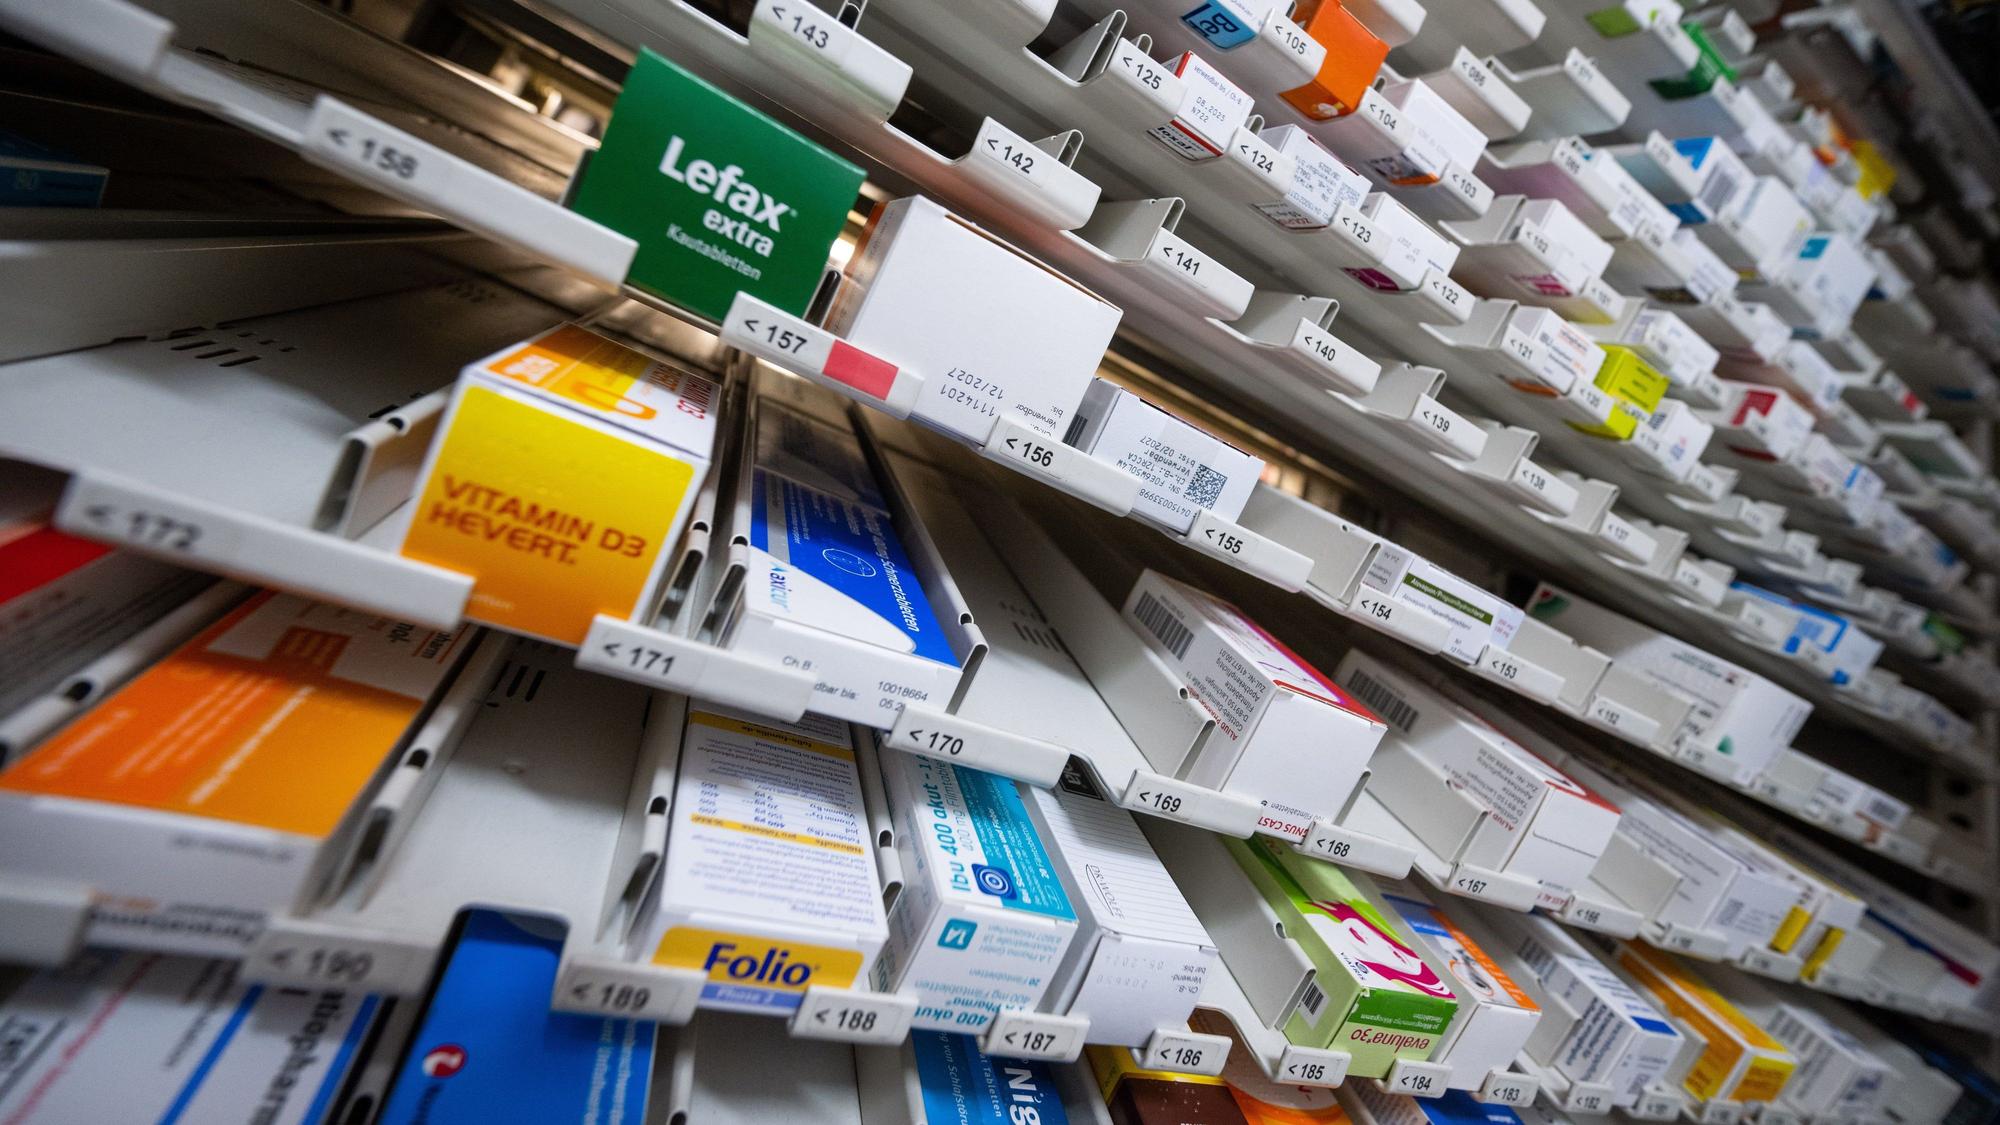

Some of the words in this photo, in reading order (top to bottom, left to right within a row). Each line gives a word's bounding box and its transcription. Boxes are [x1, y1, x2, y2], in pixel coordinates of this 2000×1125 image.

[793, 16, 829, 49] 143
[1287, 32, 1307, 55] 105
[1137, 64, 1162, 89] 125
[1380, 109, 1396, 130] 104
[360, 138, 420, 180] 158
[1004, 144, 1034, 174] 142
[1252, 149, 1274, 174] 124
[703, 208, 775, 258] extra
[1352, 223, 1372, 243] 123
[666, 223, 762, 281] Kautabletten
[1176, 252, 1200, 276] 141
[1442, 286, 1459, 305] 122
[767, 325, 808, 354] 157
[1315, 340, 1336, 362] 140
[1432, 413, 1450, 432] 139
[1023, 442, 1054, 467] 156
[1143, 449, 1191, 476] Verwendbar
[1529, 472, 1545, 490] 138
[442, 474, 594, 542] VITAMIN
[599, 527, 648, 558] D3
[1217, 532, 1244, 554] 155
[1372, 601, 1392, 620] 154
[630, 646, 677, 676] 171
[1499, 660, 1517, 679] 153
[929, 732, 964, 755] 170
[927, 784, 948, 819] akut
[1153, 793, 1182, 813] 169
[937, 822, 958, 856] 400
[1328, 840, 1350, 858] 168
[951, 861, 972, 892] Ibu
[1468, 876, 1487, 894] 167
[308, 949, 373, 982] 190
[703, 942, 812, 987] Folio
[600, 983, 652, 1011] 189
[838, 1010, 877, 1030] 188
[914, 1005, 954, 1020] akut
[956, 1014, 988, 1027] 400
[1022, 1032, 1056, 1052] 187
[1175, 1047, 1202, 1066] 186
[1300, 1063, 1325, 1081] 185
[1412, 1074, 1432, 1090] 184
[984, 1067, 1001, 1118] Tabletten
[1501, 1088, 1520, 1101] 183
